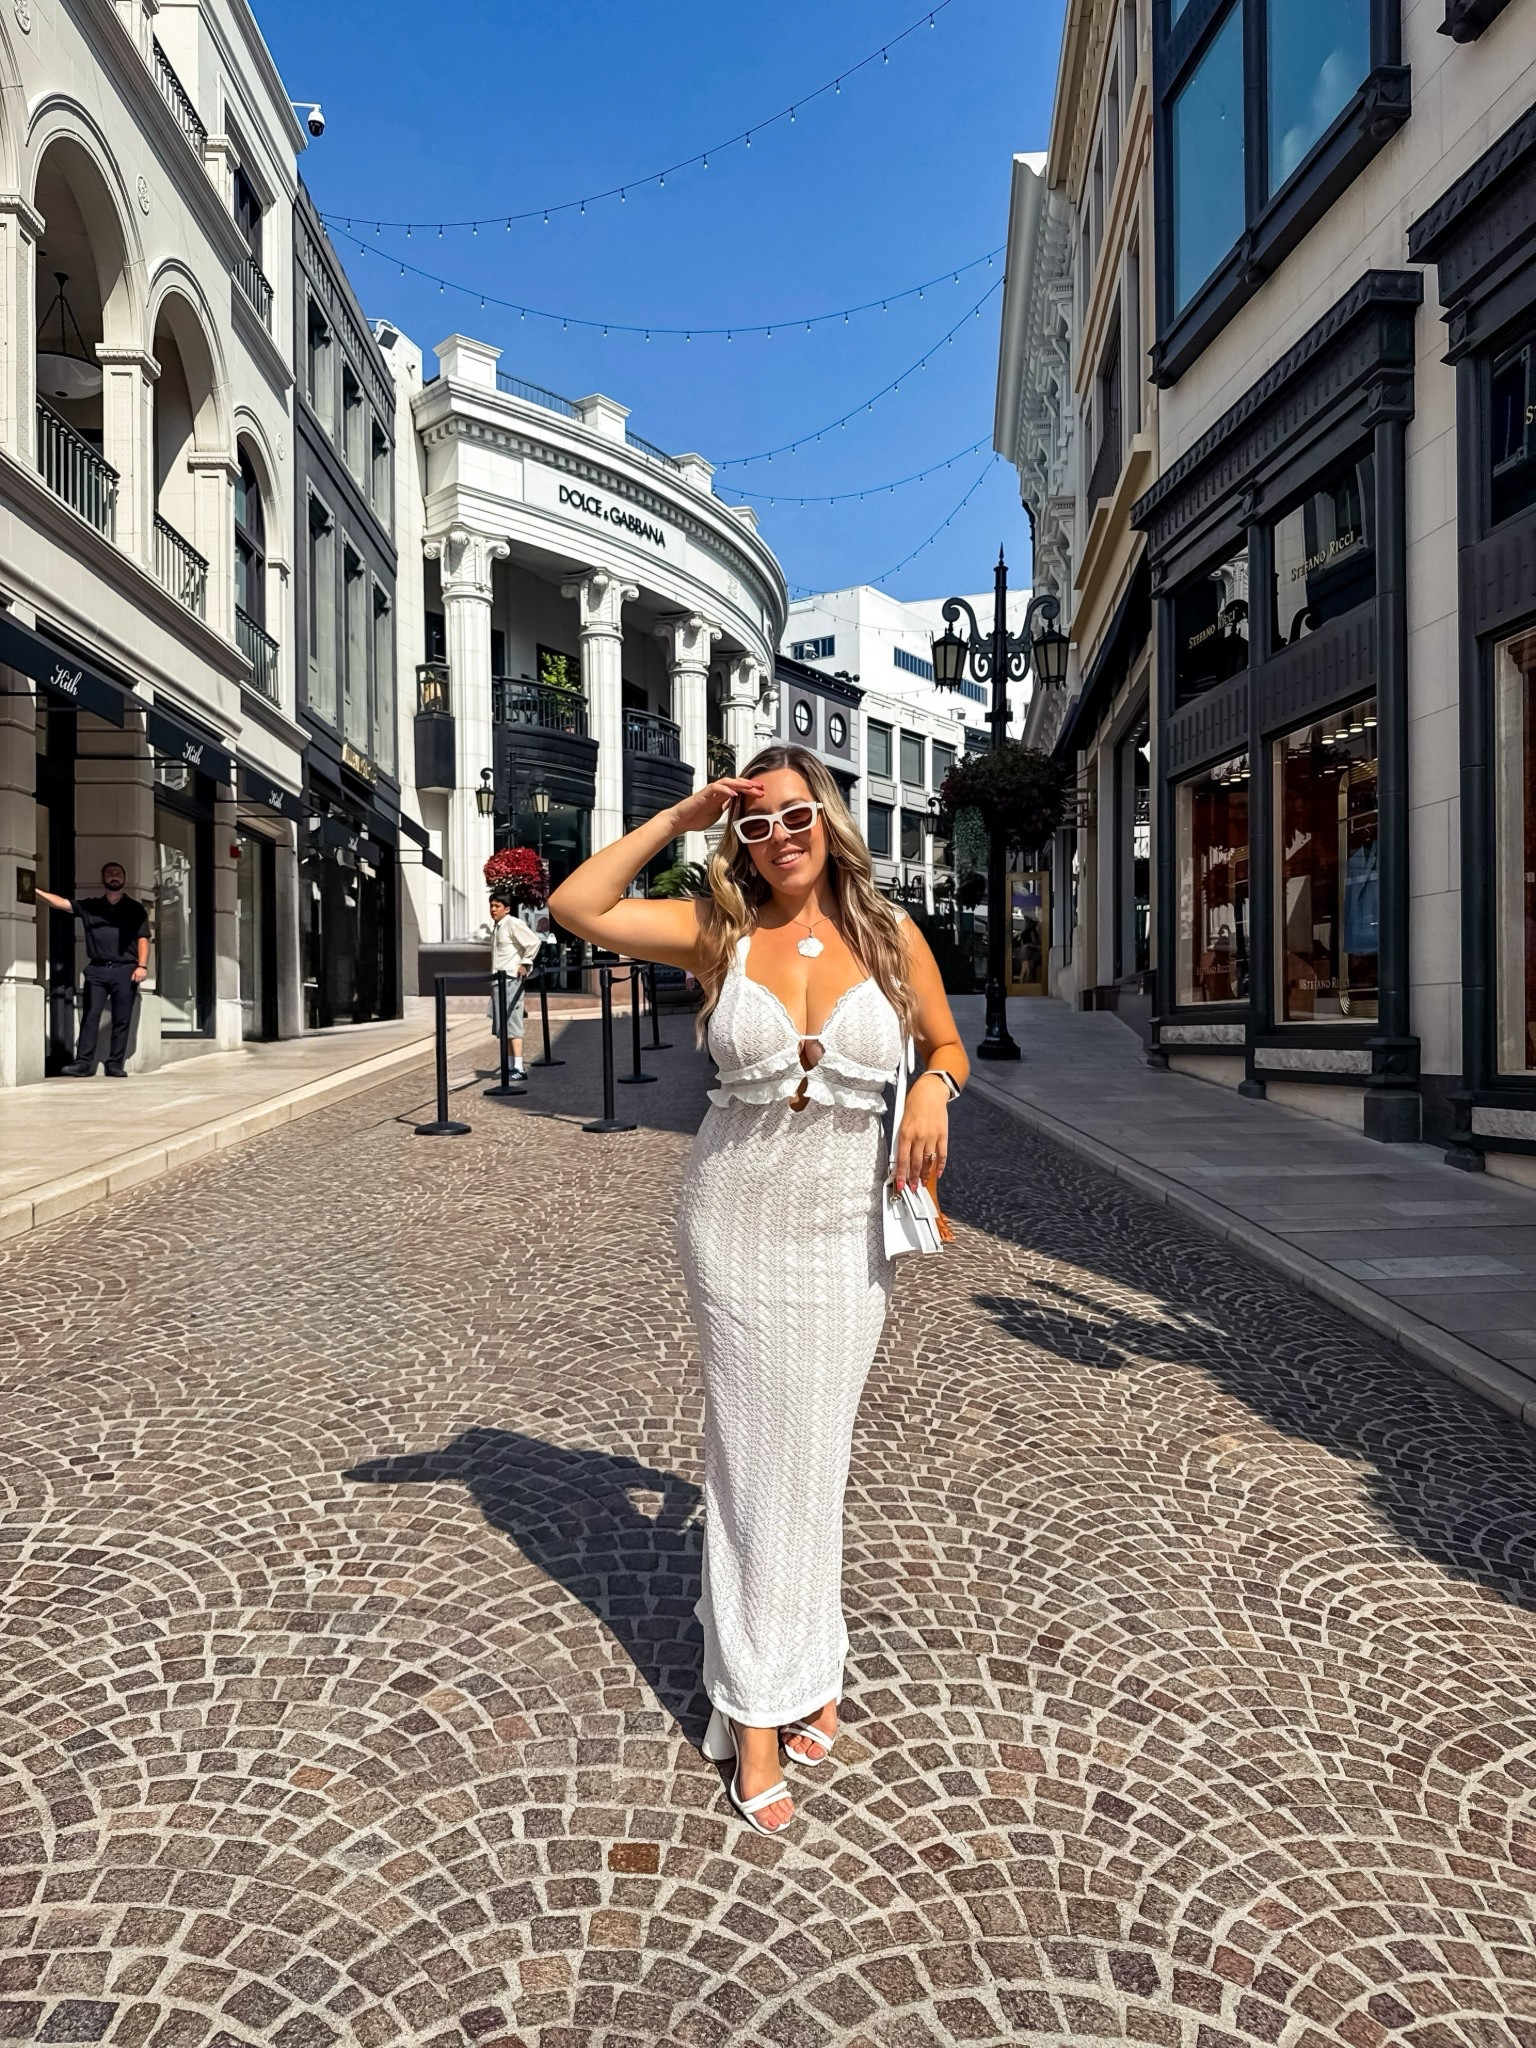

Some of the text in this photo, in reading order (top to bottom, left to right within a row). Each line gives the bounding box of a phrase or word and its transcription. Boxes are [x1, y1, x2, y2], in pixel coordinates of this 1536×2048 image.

[559, 484, 666, 548] DOLCE & GABBANA
[1291, 530, 1354, 582] STEFANO RICCI
[1188, 624, 1216, 650] STEFANO
[50, 664, 83, 696] Kith
